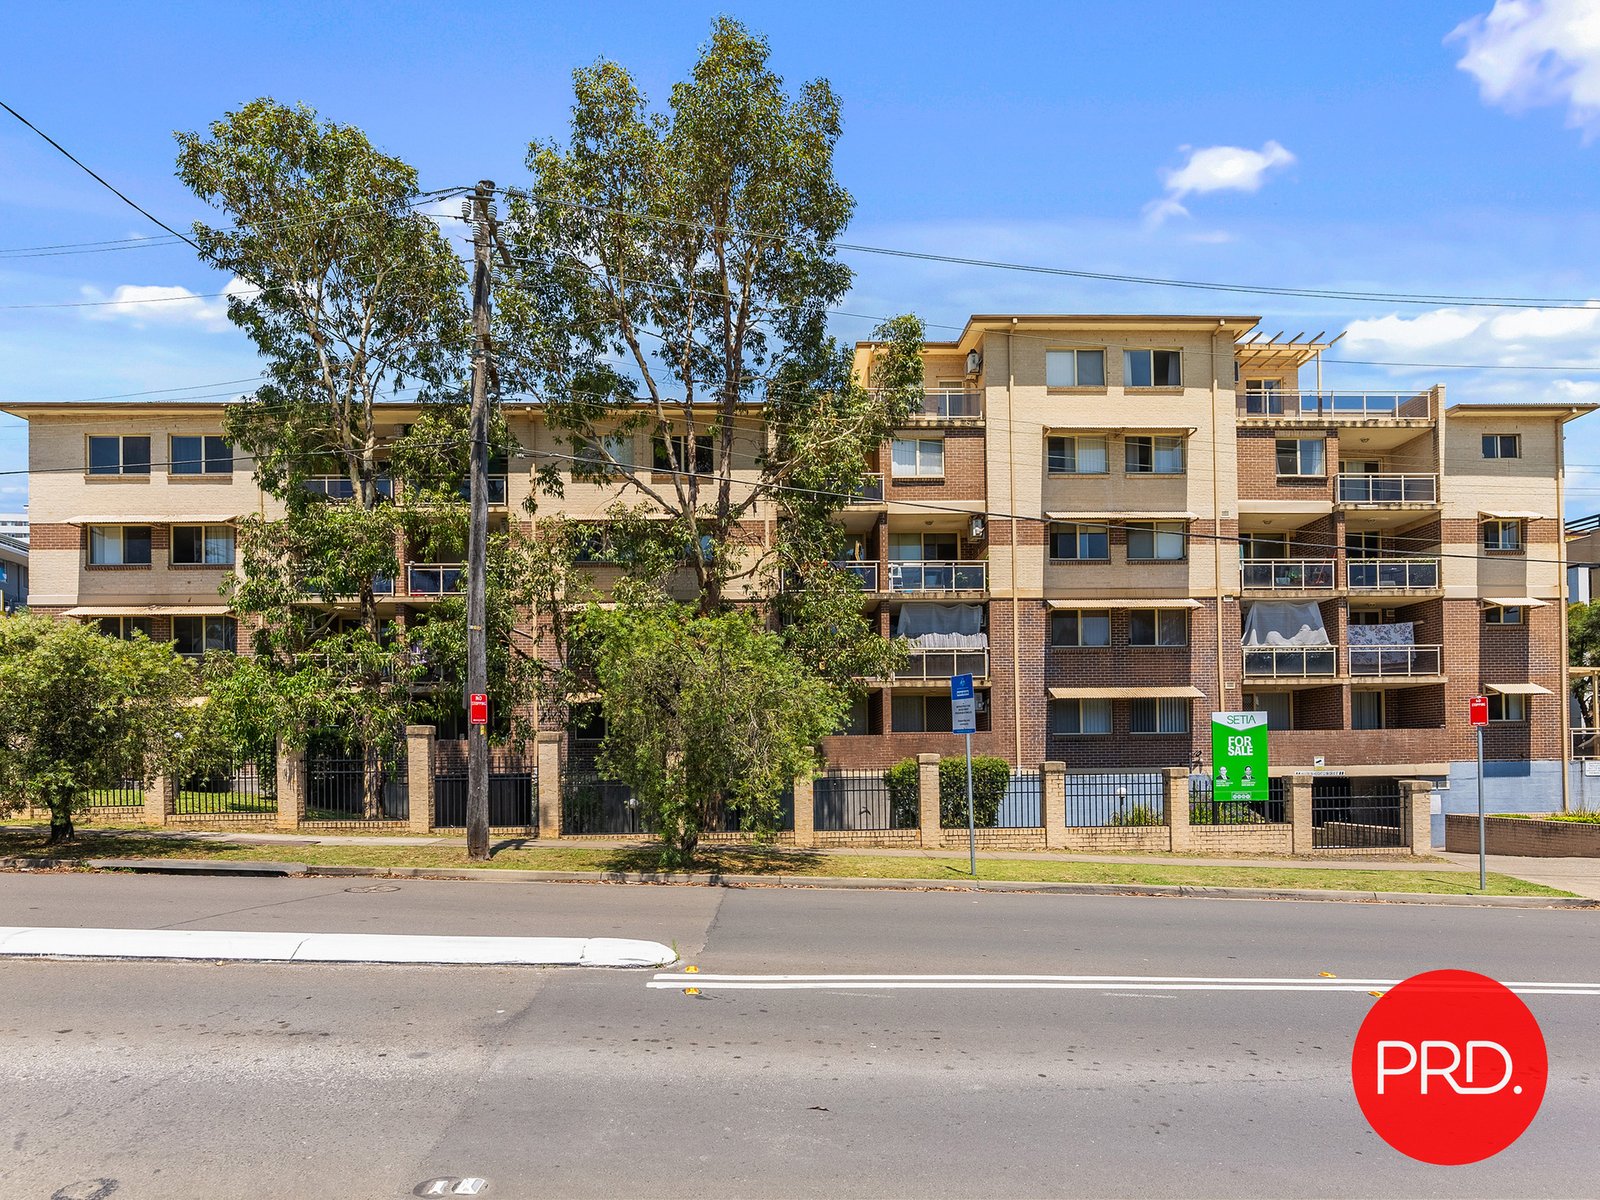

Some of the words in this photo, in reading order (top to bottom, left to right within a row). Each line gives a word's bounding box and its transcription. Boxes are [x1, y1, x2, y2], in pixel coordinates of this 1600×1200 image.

[1226, 714, 1256, 724] SETIA
[1228, 736, 1252, 747] FOR
[1228, 746, 1254, 756] SALE
